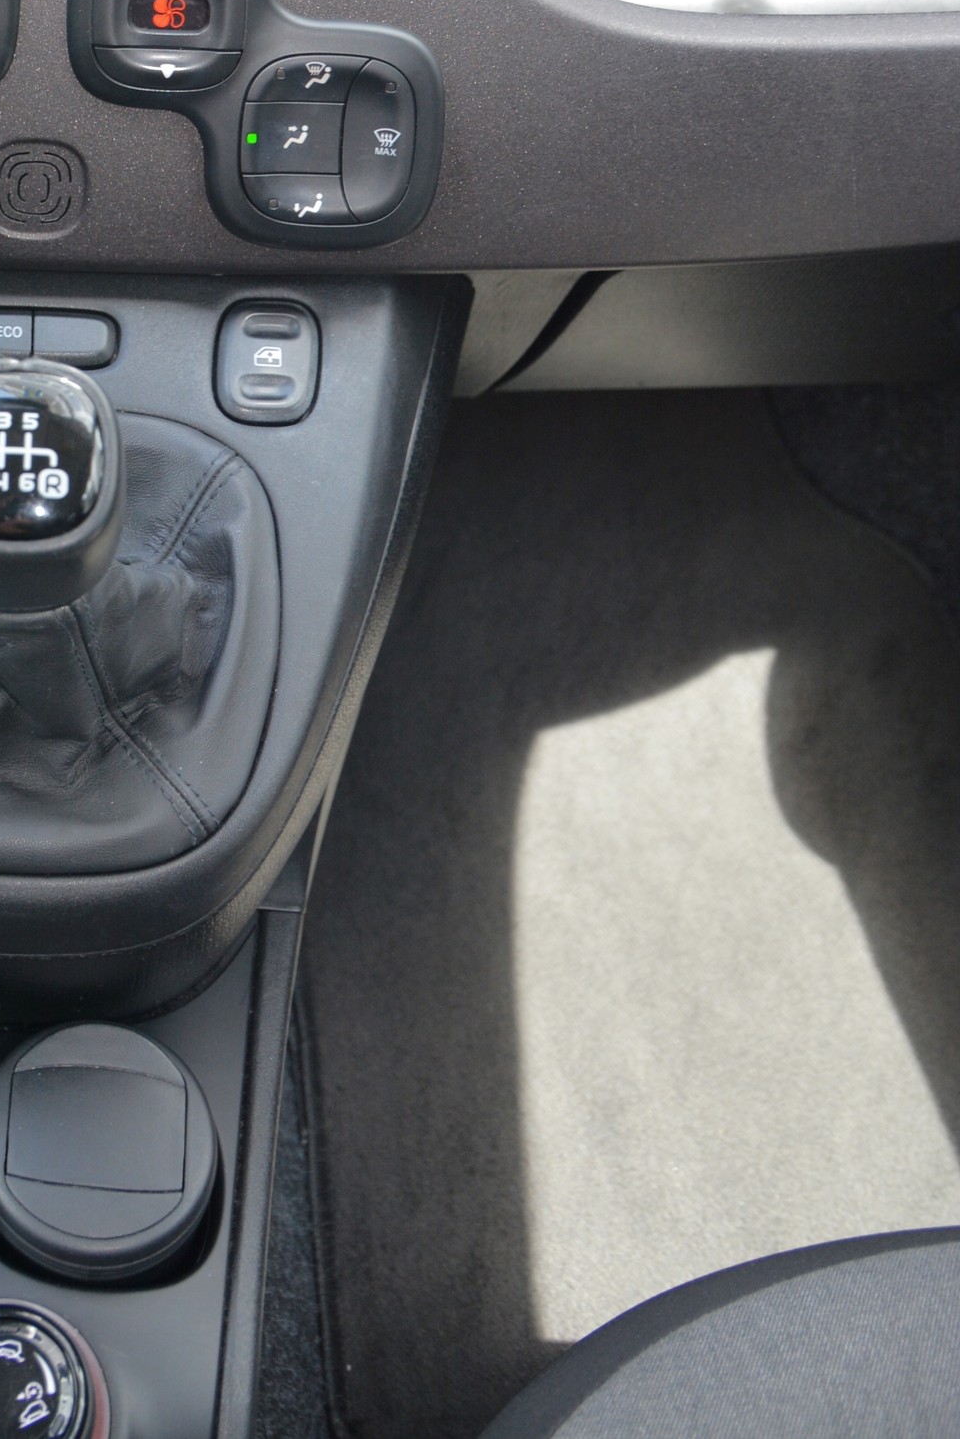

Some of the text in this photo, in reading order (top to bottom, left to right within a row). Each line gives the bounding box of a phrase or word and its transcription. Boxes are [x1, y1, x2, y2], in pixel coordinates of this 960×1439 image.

[374, 147, 397, 157] MAX
[21, 412, 39, 430] 5
[18, 472, 36, 492] 6
